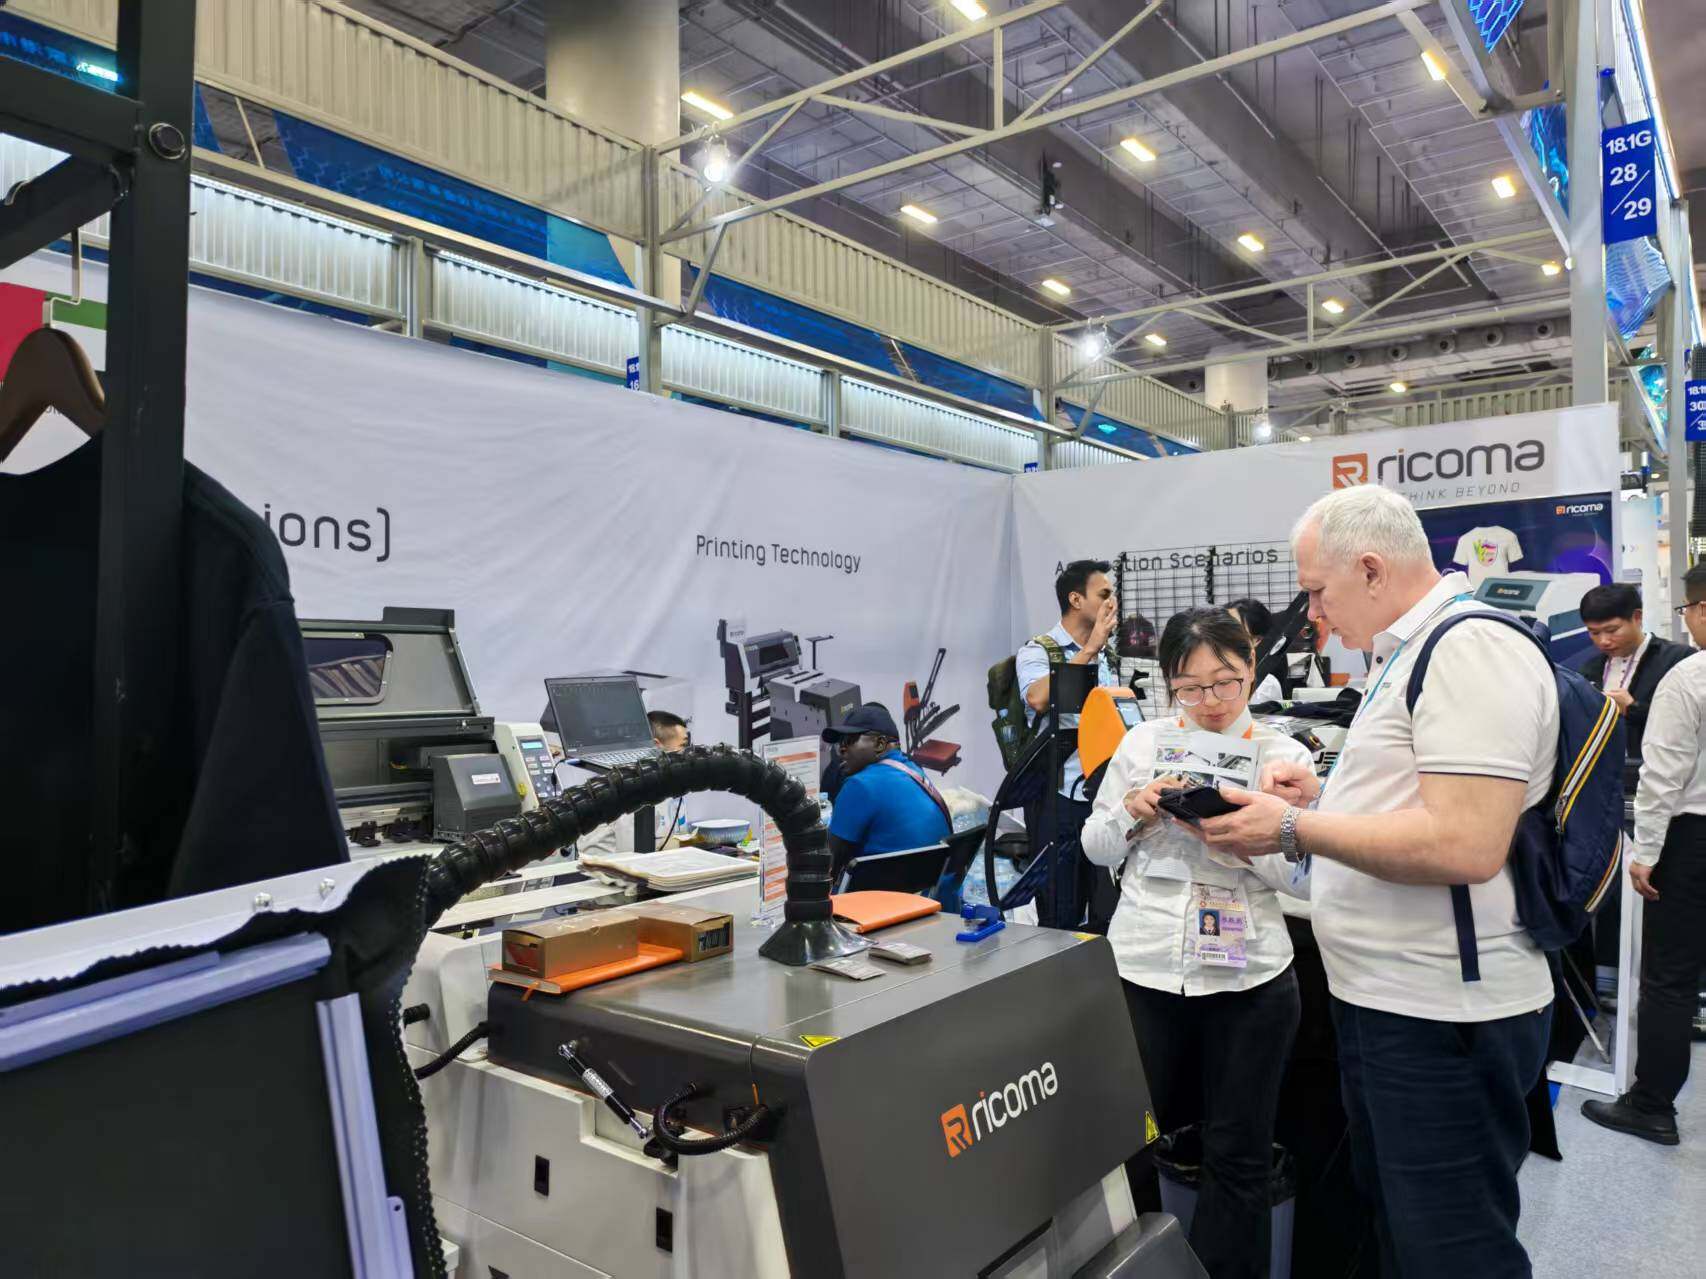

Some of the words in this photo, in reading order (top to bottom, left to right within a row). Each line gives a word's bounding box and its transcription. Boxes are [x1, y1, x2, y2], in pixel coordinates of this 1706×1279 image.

[1609, 162, 1638, 187] 28
[1623, 197, 1652, 221] 29
[1376, 439, 1545, 484] ricoma
[1401, 488, 1449, 501] HINK
[1455, 481, 1521, 498] BEYOND
[1566, 503, 1604, 514] ricoma
[696, 534, 766, 566] Printing
[771, 543, 861, 574] Technology
[1169, 547, 1279, 570] Scenarios
[971, 1061, 1059, 1142] ricoma
